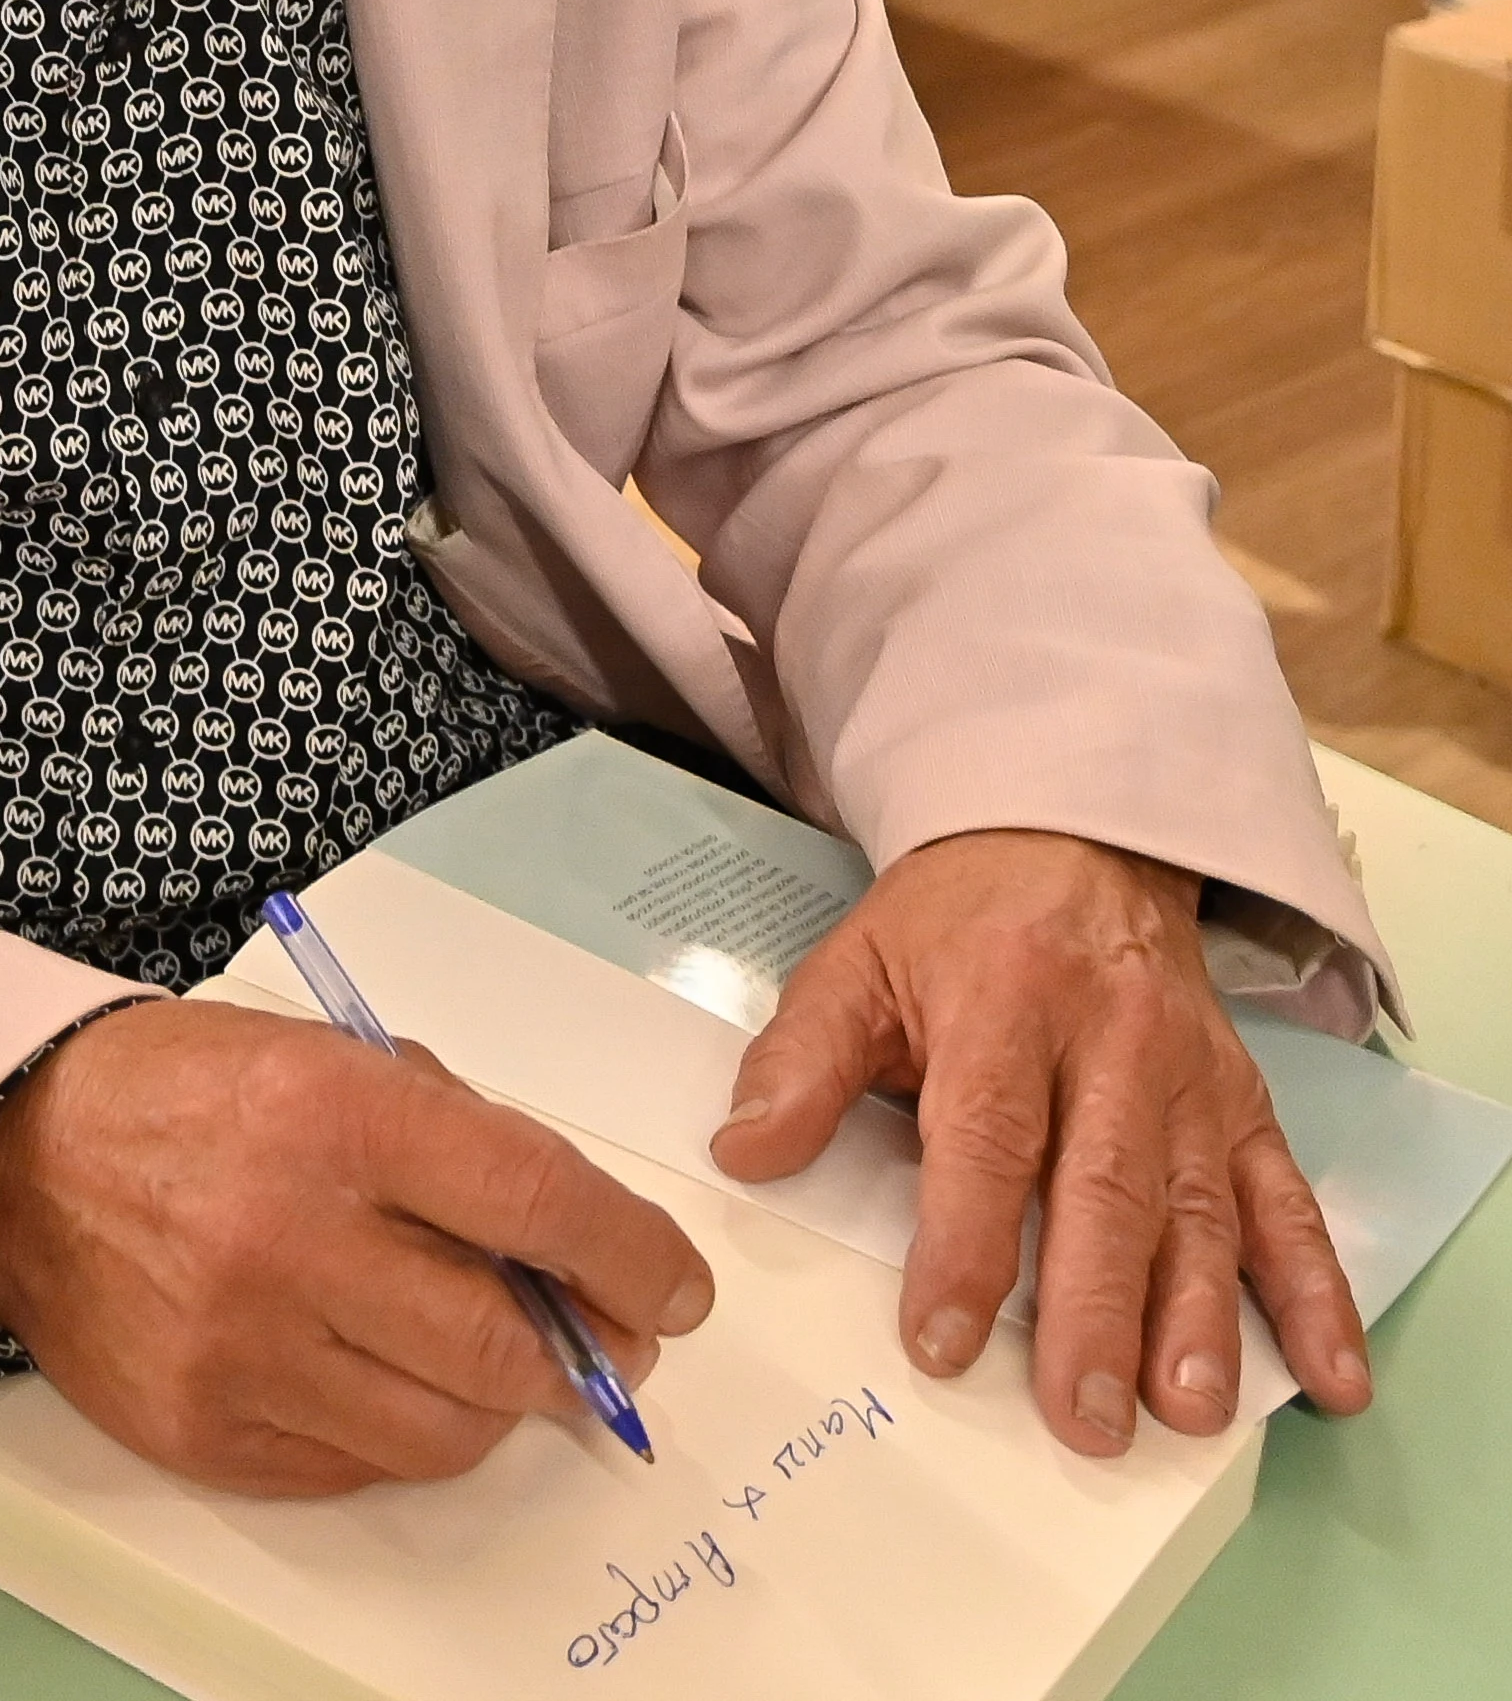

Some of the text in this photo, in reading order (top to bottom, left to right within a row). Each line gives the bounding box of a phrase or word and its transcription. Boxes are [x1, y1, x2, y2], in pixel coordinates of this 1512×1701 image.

[5, 5, 39, 27] MK
[66, 9, 97, 28] MK
[209, 34, 240, 53] MK
[35, 62, 69, 82] MK
[319, 54, 347, 73] MK
[184, 85, 220, 109] MK
[242, 88, 273, 109] MK
[127, 98, 160, 120] MK
[6, 110, 40, 130] MK
[221, 141, 252, 160] MK
[272, 143, 306, 165] MK
[0, 167, 22, 187] MK
[38, 162, 72, 182] MK
[104, 157, 139, 179] MK
[134, 200, 170, 224] MK
[196, 193, 230, 213] MK
[251, 197, 279, 218] MK
[305, 198, 339, 220] MK
[29, 217, 56, 241] MK
[78, 211, 113, 233] MK
[230, 248, 258, 267] MK
[281, 255, 312, 274] MK
[110, 257, 146, 281] MK
[17, 280, 48, 299] MK
[144, 305, 180, 329] MK
[205, 299, 239, 319] MK
[261, 304, 289, 323] MK
[313, 310, 344, 329] MK
[91, 316, 124, 338] MK
[45, 328, 70, 349] MK
[179, 352, 215, 376] MK
[239, 353, 270, 372] MK
[289, 361, 317, 380] MK
[341, 363, 375, 383] MK
[17, 384, 50, 406] MK
[69, 374, 105, 398] MK
[163, 412, 196, 434] MK
[216, 403, 249, 425] MK
[270, 408, 297, 429] MK
[113, 422, 144, 446] MK
[317, 417, 345, 438] MK
[53, 433, 86, 457] MK
[200, 460, 233, 484] MK
[251, 454, 284, 476] MK
[152, 469, 183, 493] MK
[344, 472, 378, 492] MK
[84, 484, 115, 503] MK
[182, 522, 210, 541] MK
[276, 511, 305, 532] MK
[138, 530, 164, 551] MK
[377, 525, 408, 546] MK
[242, 561, 274, 582] MK
[298, 569, 327, 592] MK
[351, 579, 380, 600] MK
[42, 601, 74, 622] MK
[208, 612, 240, 633] MK
[263, 619, 292, 642] MK
[317, 628, 346, 651] MK
[5, 649, 37, 670] MK
[121, 664, 150, 685] MK
[174, 663, 203, 684] MK
[228, 670, 257, 693] MK
[284, 680, 316, 701] MK
[27, 708, 59, 729] MK
[87, 715, 116, 736] MK
[198, 719, 230, 740] MK
[253, 729, 285, 750] MK
[310, 734, 343, 752] MK
[165, 770, 199, 790] MK
[222, 775, 256, 795] MK
[281, 783, 313, 802] MK
[8, 806, 39, 830] MK
[80, 823, 114, 843] MK
[139, 824, 170, 845] MK
[194, 826, 228, 848] MK
[251, 830, 285, 850] MK
[21, 865, 55, 890] MK
[106, 878, 140, 898] MK
[163, 878, 194, 896] MK
[567, 1531, 735, 1669] Amparo
